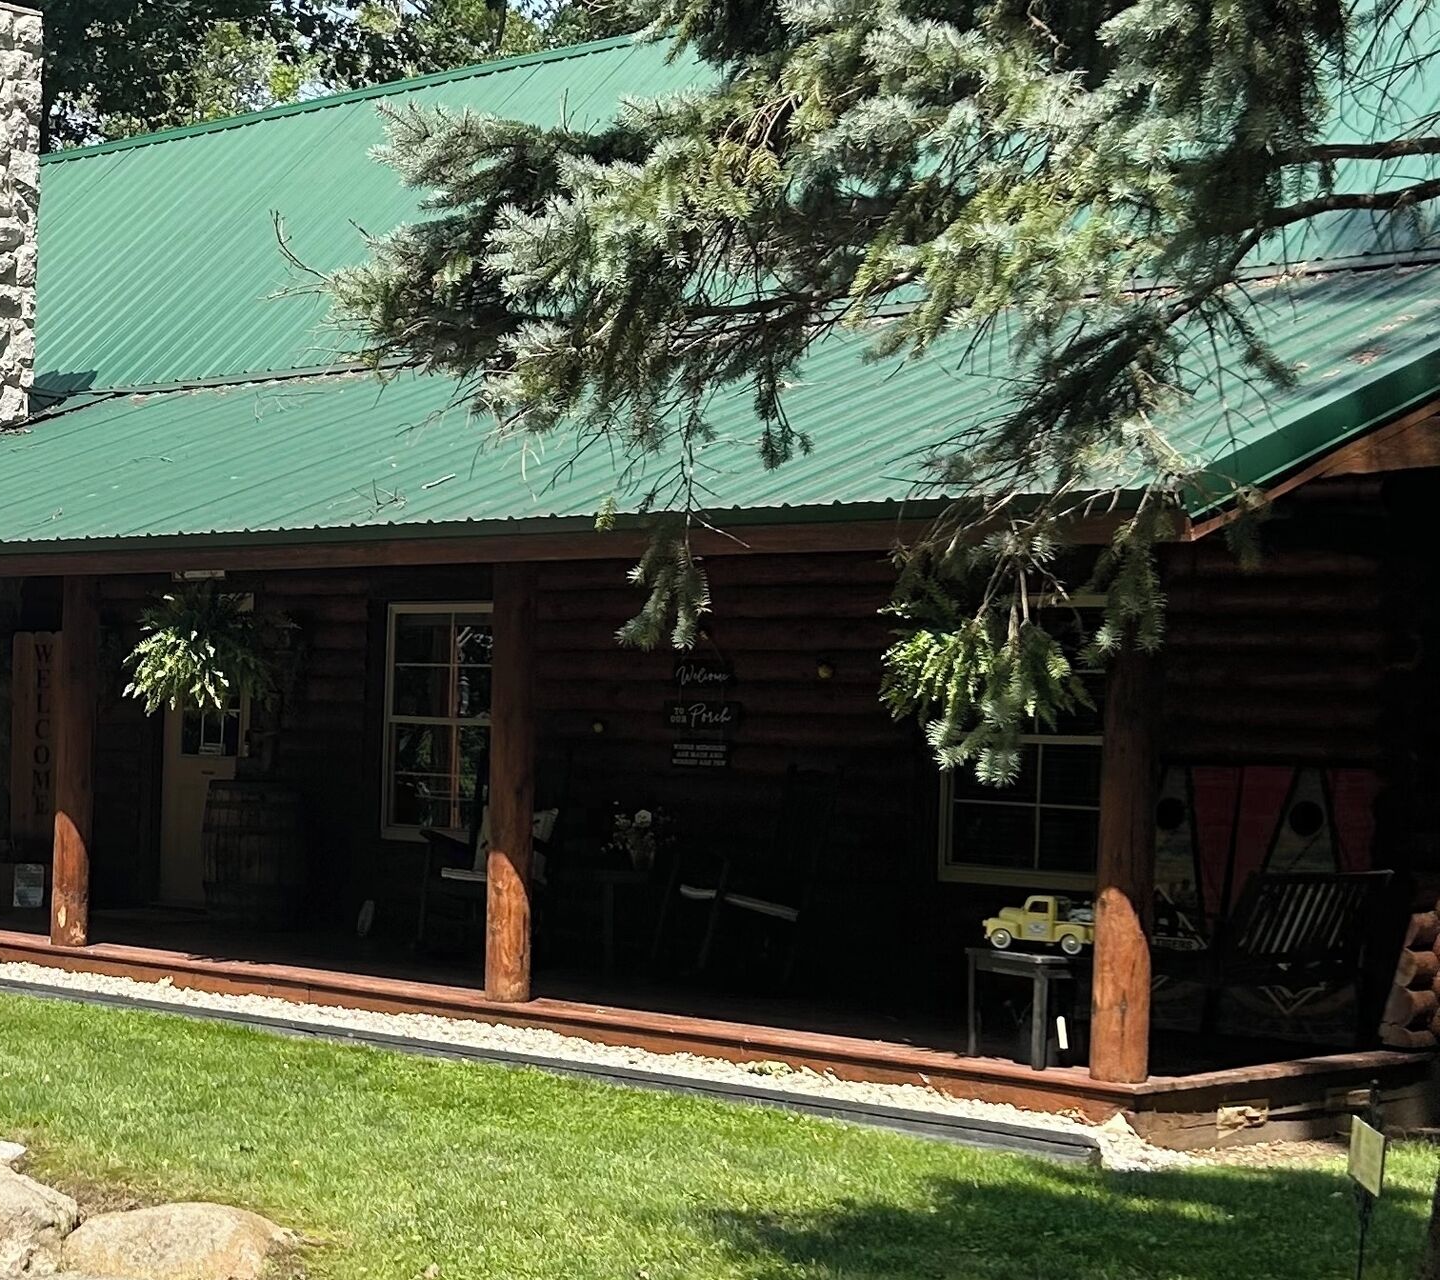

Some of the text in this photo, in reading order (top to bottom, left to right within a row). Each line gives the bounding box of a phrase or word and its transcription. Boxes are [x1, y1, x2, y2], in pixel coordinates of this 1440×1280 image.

[675, 664, 730, 686] Welcome
[688, 702, 732, 728] Porch
[32, 644, 53, 816] WELCOME
